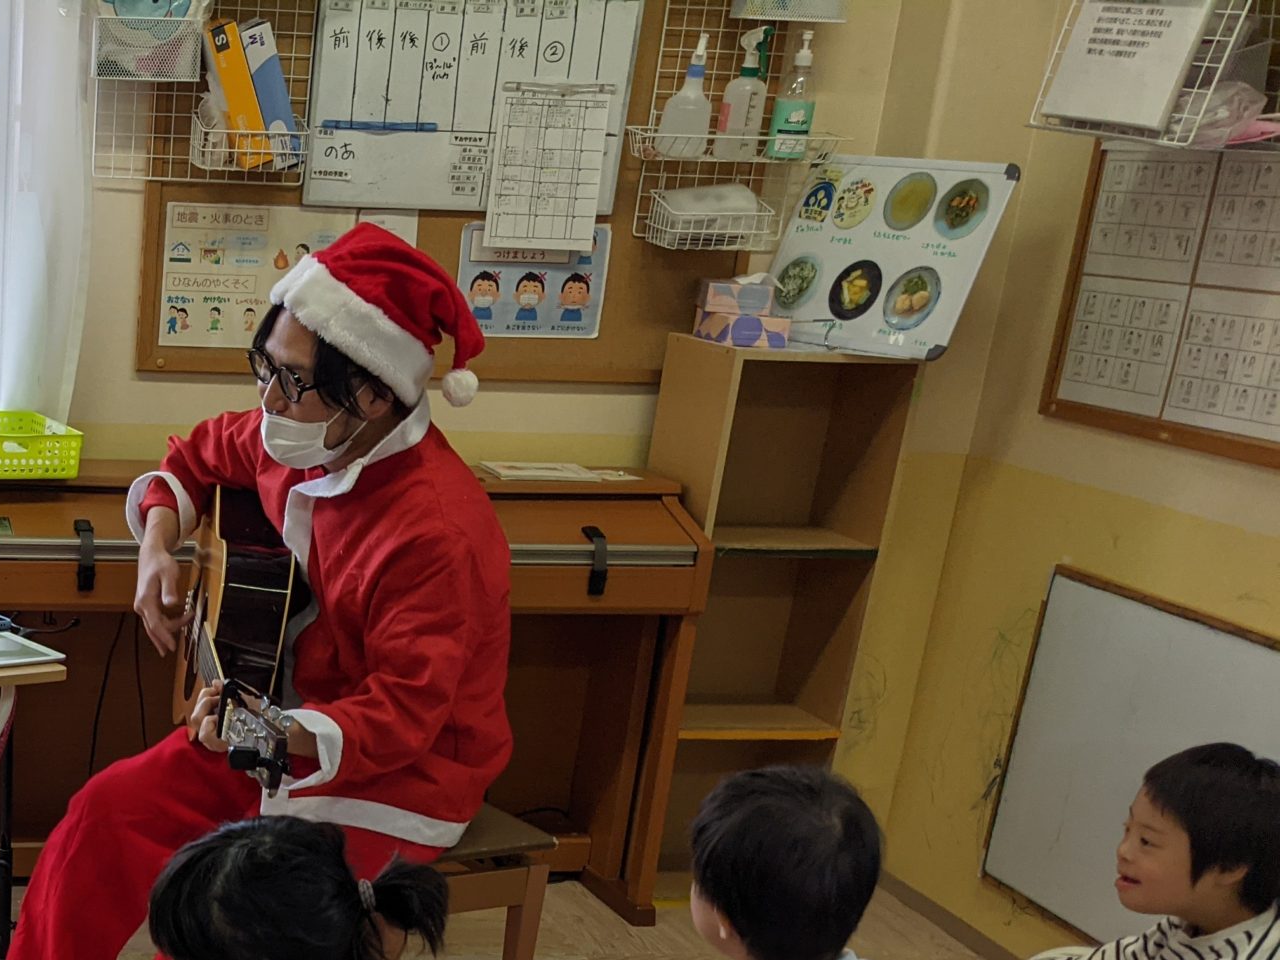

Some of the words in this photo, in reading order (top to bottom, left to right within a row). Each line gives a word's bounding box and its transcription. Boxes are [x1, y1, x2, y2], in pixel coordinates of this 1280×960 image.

[215, 34, 227, 46] S
[329, 27, 350, 50] 前
[366, 29, 386, 51] 後
[400, 30, 419, 51] 後
[470, 32, 489, 57] 前
[509, 37, 529, 58] 後
[324, 143, 355, 160] のあ
[176, 212, 266, 226] 地震・火事のとき
[494, 250, 546, 260] つけましょう
[172, 277, 250, 289] ひなんのやくそく
[166, 295, 195, 304] おさない
[203, 295, 230, 304] かけない
